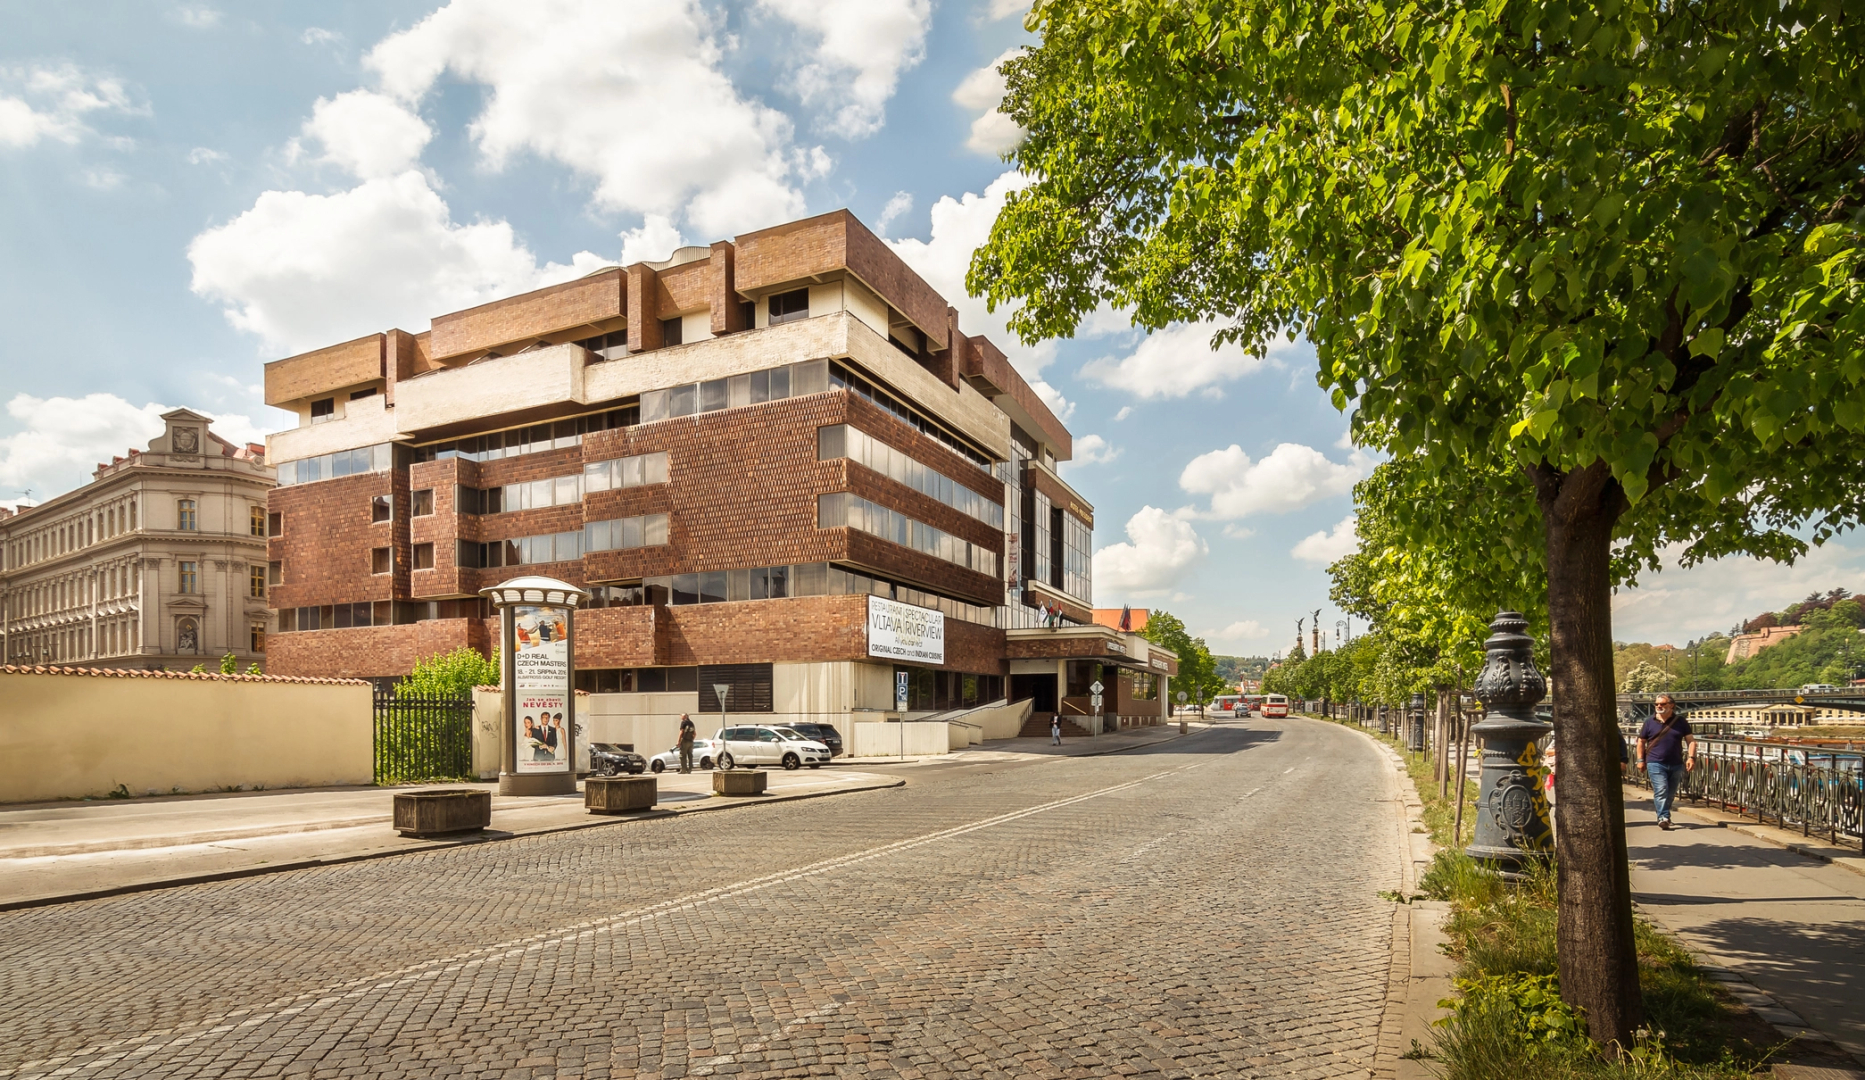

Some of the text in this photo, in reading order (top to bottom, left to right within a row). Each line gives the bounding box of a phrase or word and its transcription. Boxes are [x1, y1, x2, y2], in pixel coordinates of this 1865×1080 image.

[905, 608, 942, 625] SPECTACULAR
[871, 612, 943, 640] VLTAVA RIVERVIEW
[871, 643, 892, 654] ORIGINAL
[892, 646, 907, 655] CZECH
[915, 649, 929, 659] INDIAN
[928, 651, 943, 660] CUISINE
